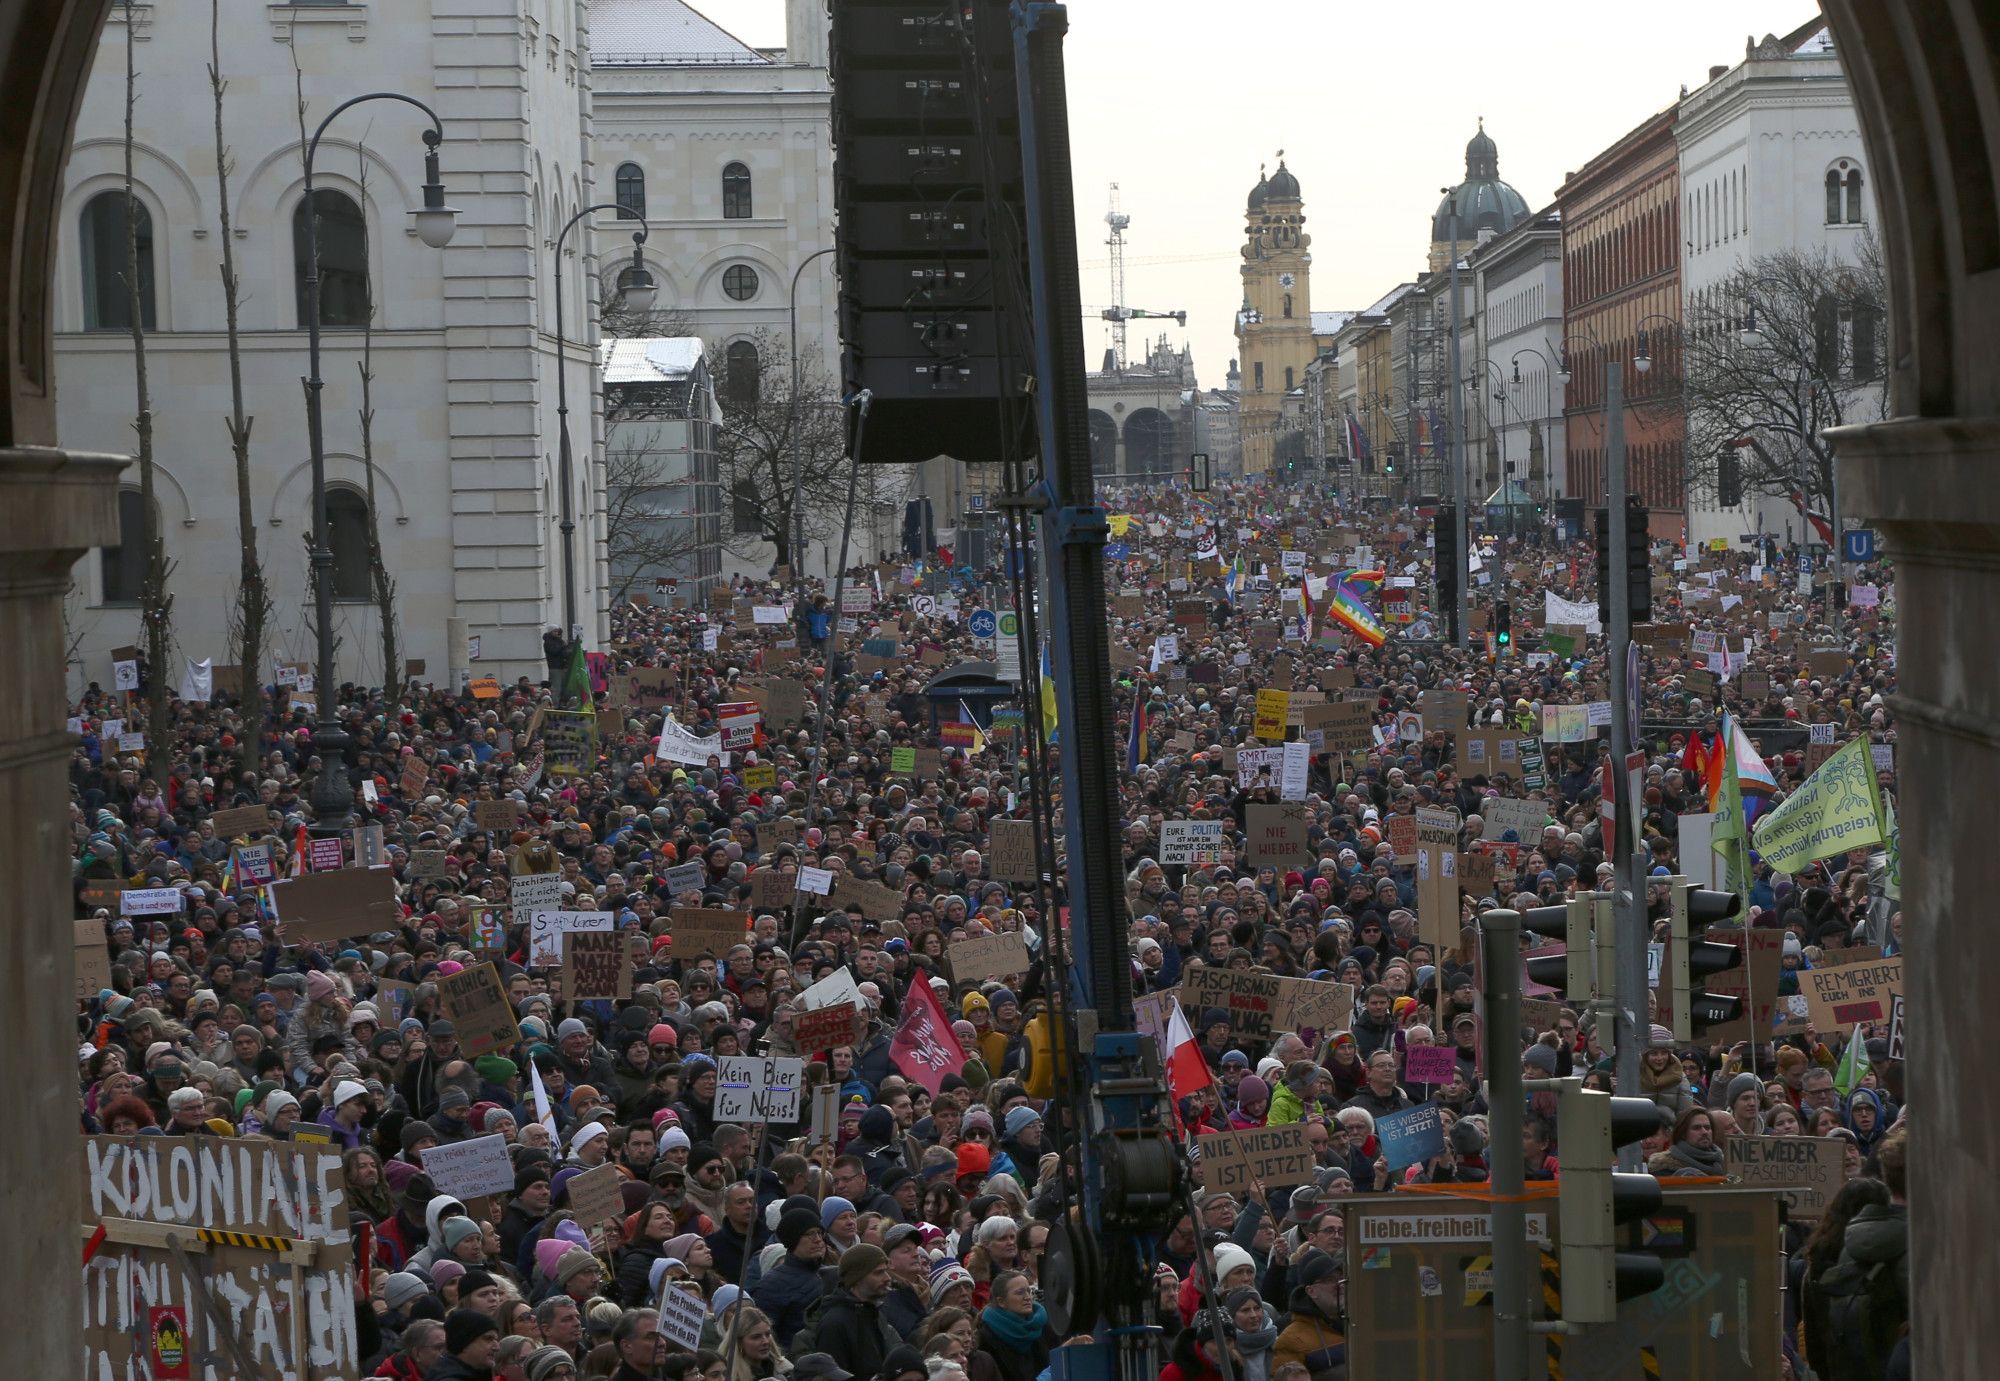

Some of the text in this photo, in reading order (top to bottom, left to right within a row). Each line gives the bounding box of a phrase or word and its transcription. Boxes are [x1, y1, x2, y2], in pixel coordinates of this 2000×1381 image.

[1850, 536, 1867, 556] U
[1801, 559, 1808, 570] P
[656, 584, 677, 594] AfD
[1388, 602, 1410, 614] EKEL
[1005, 618, 1015, 630] H
[631, 678, 674, 703] Spenden
[732, 727, 754, 737] ohne
[1811, 727, 1832, 737] NIE
[725, 738, 752, 749] Rechts
[1239, 750, 1266, 762] SMRT
[996, 823, 1033, 838] ENDLIC
[1166, 825, 1222, 836] EURE POLITIK
[1266, 827, 1287, 838] NIE
[1006, 837, 1029, 850] MAL
[1164, 843, 1220, 851] STUMMER SCHREI
[1258, 844, 1300, 856] WIEDER
[243, 849, 260, 860] NIE
[994, 849, 1034, 863] NORMAL
[1166, 851, 1219, 863] NACH LIEBE
[996, 863, 1034, 876] LEUTE
[512, 876, 561, 887] Faschismus
[126, 889, 178, 905] Demokratie ist
[513, 886, 561, 898] darf nicht
[127, 900, 178, 913] bunt und sexy
[571, 931, 625, 953] MAKE
[572, 952, 623, 970] NAZIS
[574, 970, 619, 985] AFRAID
[1187, 967, 1280, 997] FASCHISMUS
[1812, 966, 1902, 993] REMIGRIERT
[573, 984, 619, 998] AGAIN
[1823, 988, 1876, 1003] EUCH INS
[1199, 991, 1269, 1012] IST keine
[719, 1060, 795, 1086] Kein Bier
[718, 1090, 796, 1119] für Nazis!
[1379, 1108, 1437, 1133] NIE WIEDER
[1386, 1118, 1435, 1142] IST JETZT!
[1203, 1129, 1303, 1161] NIE WIEDER
[1729, 1141, 1818, 1164] NIE WIEDER
[1217, 1153, 1307, 1187] IST JETZT
[1743, 1164, 1828, 1184] FASCHISMUS
[86, 1138, 350, 1246] KOLONIALE
[669, 1290, 704, 1319] Das Problem
[666, 1306, 677, 1318] sind
[677, 1310, 685, 1322] die
[663, 1320, 678, 1336] nicht
[679, 1327, 687, 1338] die
